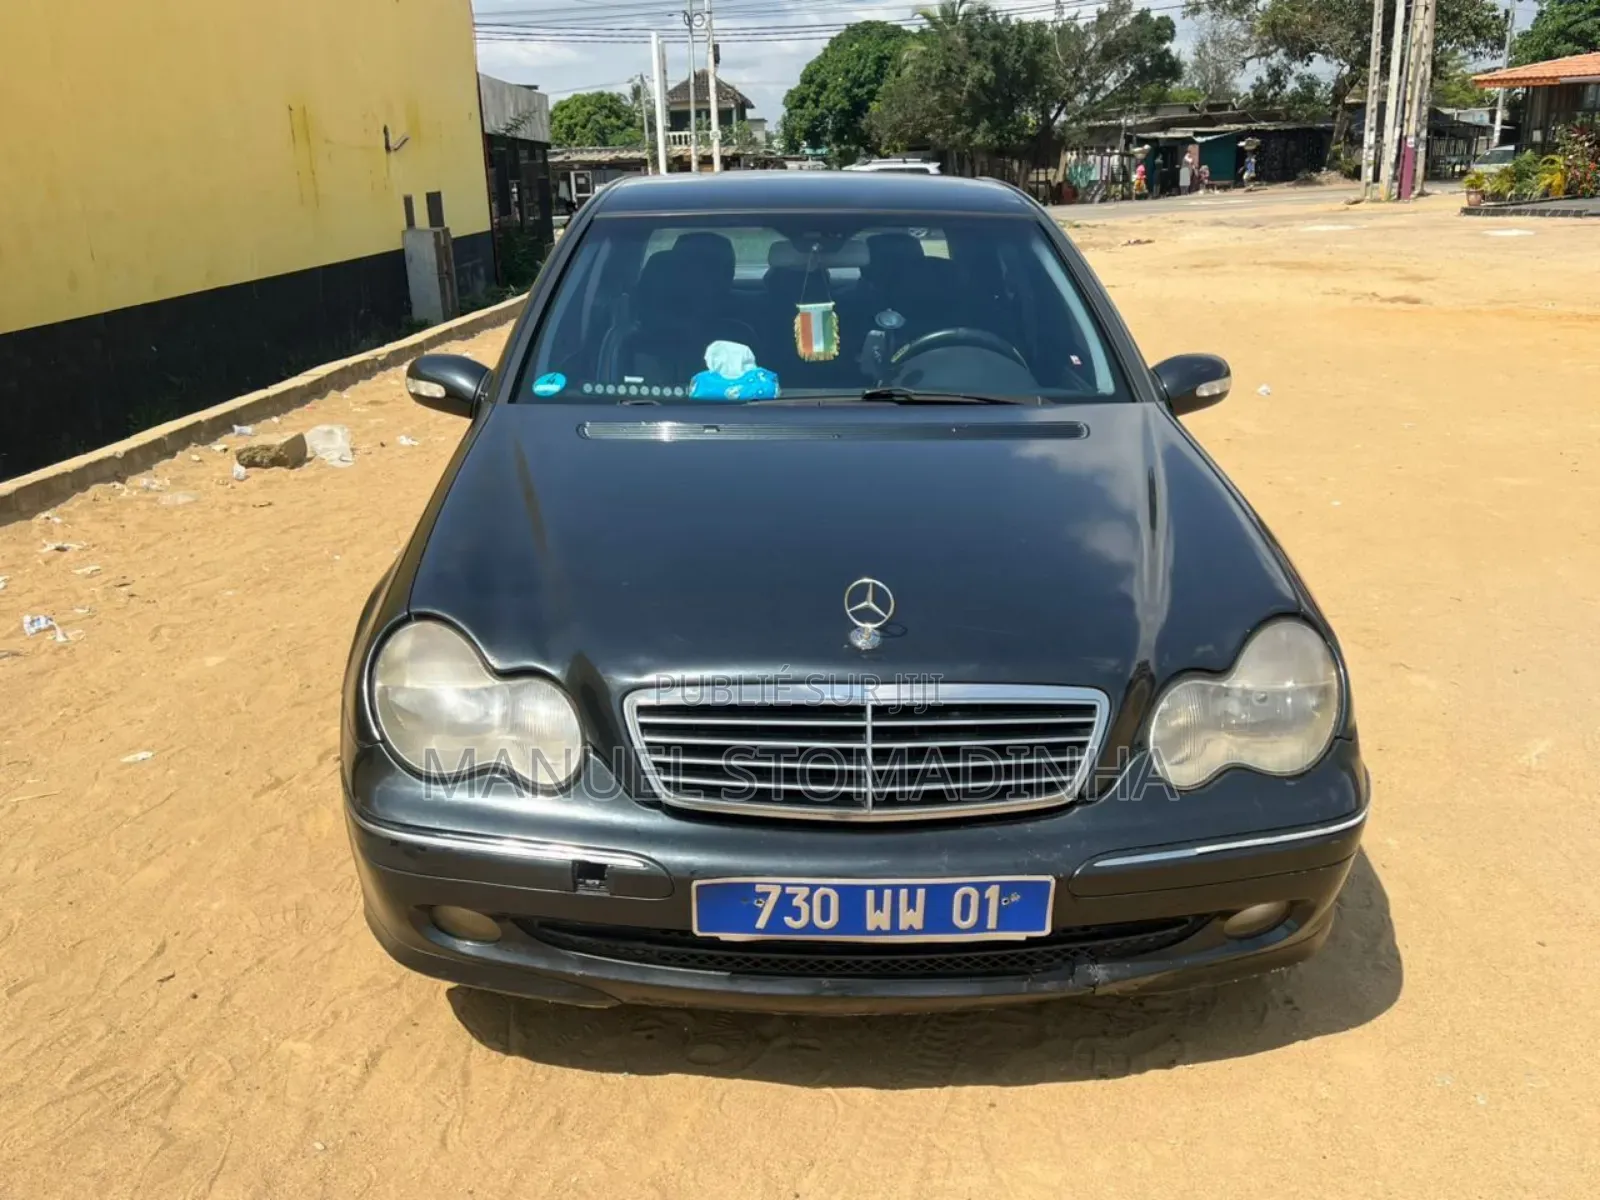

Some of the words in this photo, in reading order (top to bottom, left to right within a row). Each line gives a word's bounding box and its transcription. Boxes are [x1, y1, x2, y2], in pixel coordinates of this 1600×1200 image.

[754, 885, 839, 929] 730
[866, 888, 925, 931] WW
[953, 885, 1001, 930] 01
